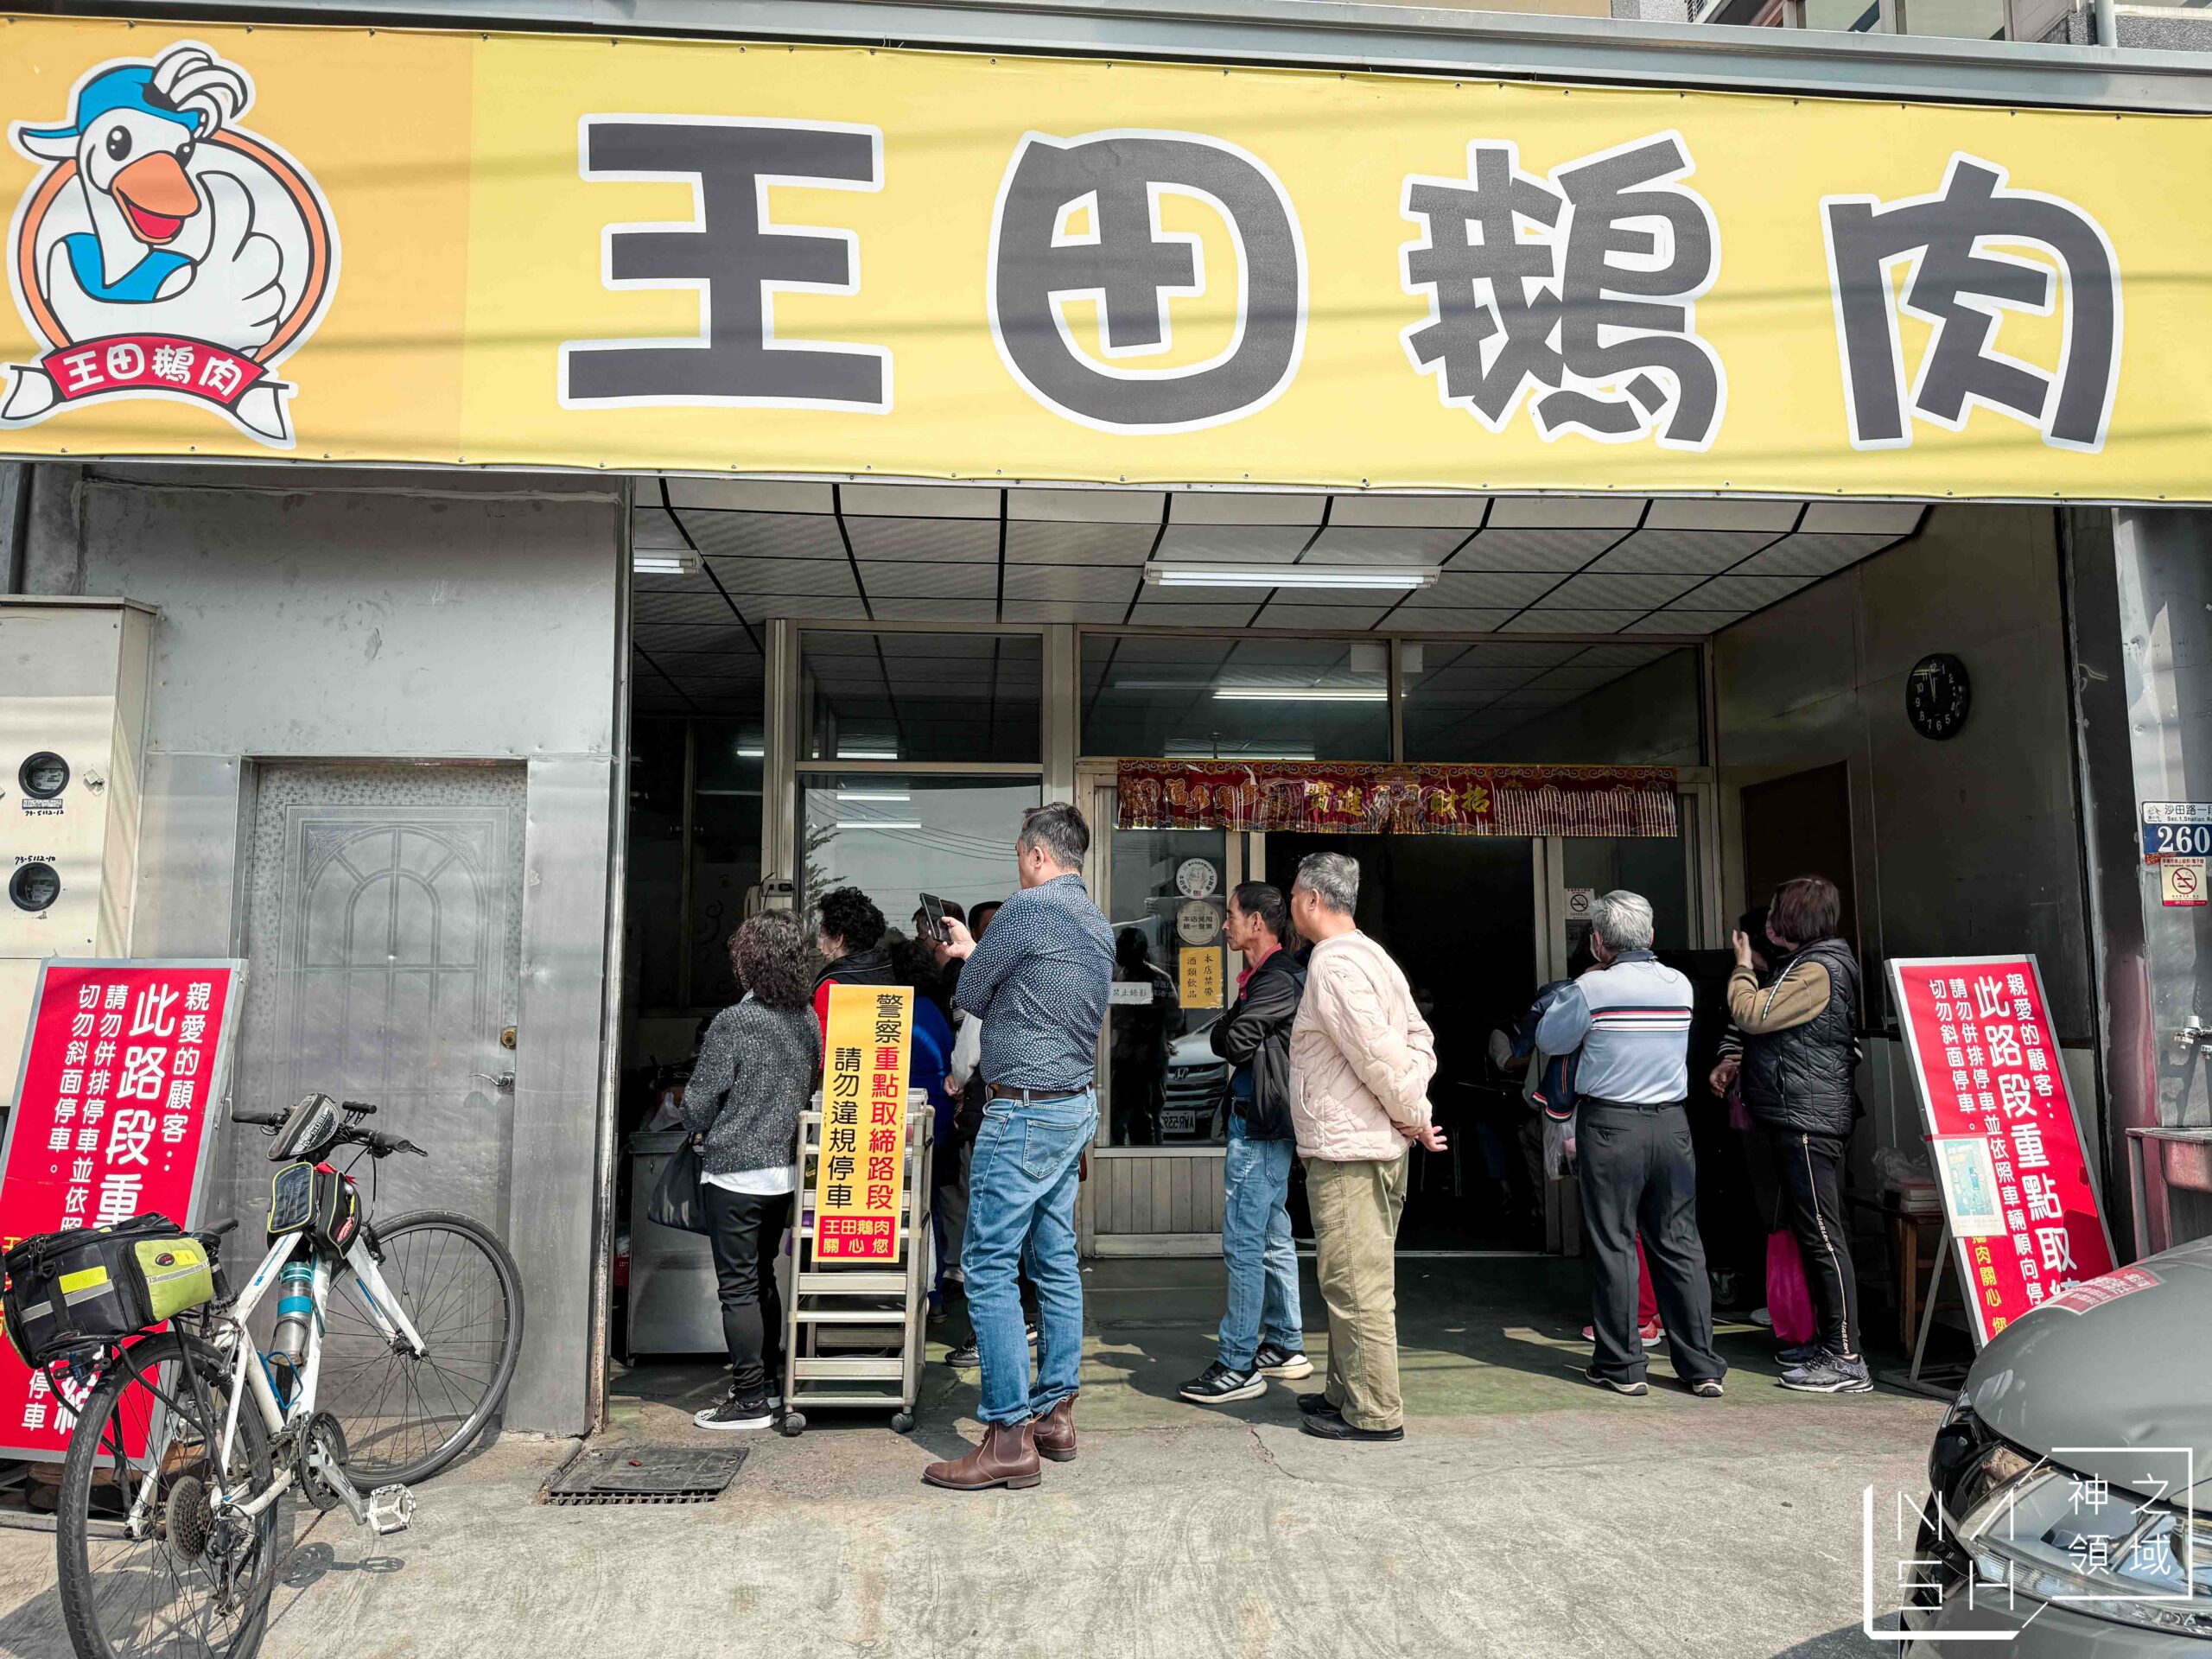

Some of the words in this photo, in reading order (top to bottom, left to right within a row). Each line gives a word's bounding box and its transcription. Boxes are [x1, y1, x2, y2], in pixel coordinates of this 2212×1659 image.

[560, 116, 2121, 454] 王田鵝肉
[62, 342, 243, 397] 王田鵝肉
[2158, 826, 2210, 854] 260
[825, 1047, 862, 1210] 請勿違規停車
[866, 994, 904, 1211] 警察重點取締路段
[824, 1219, 890, 1236] 王田鵝肉
